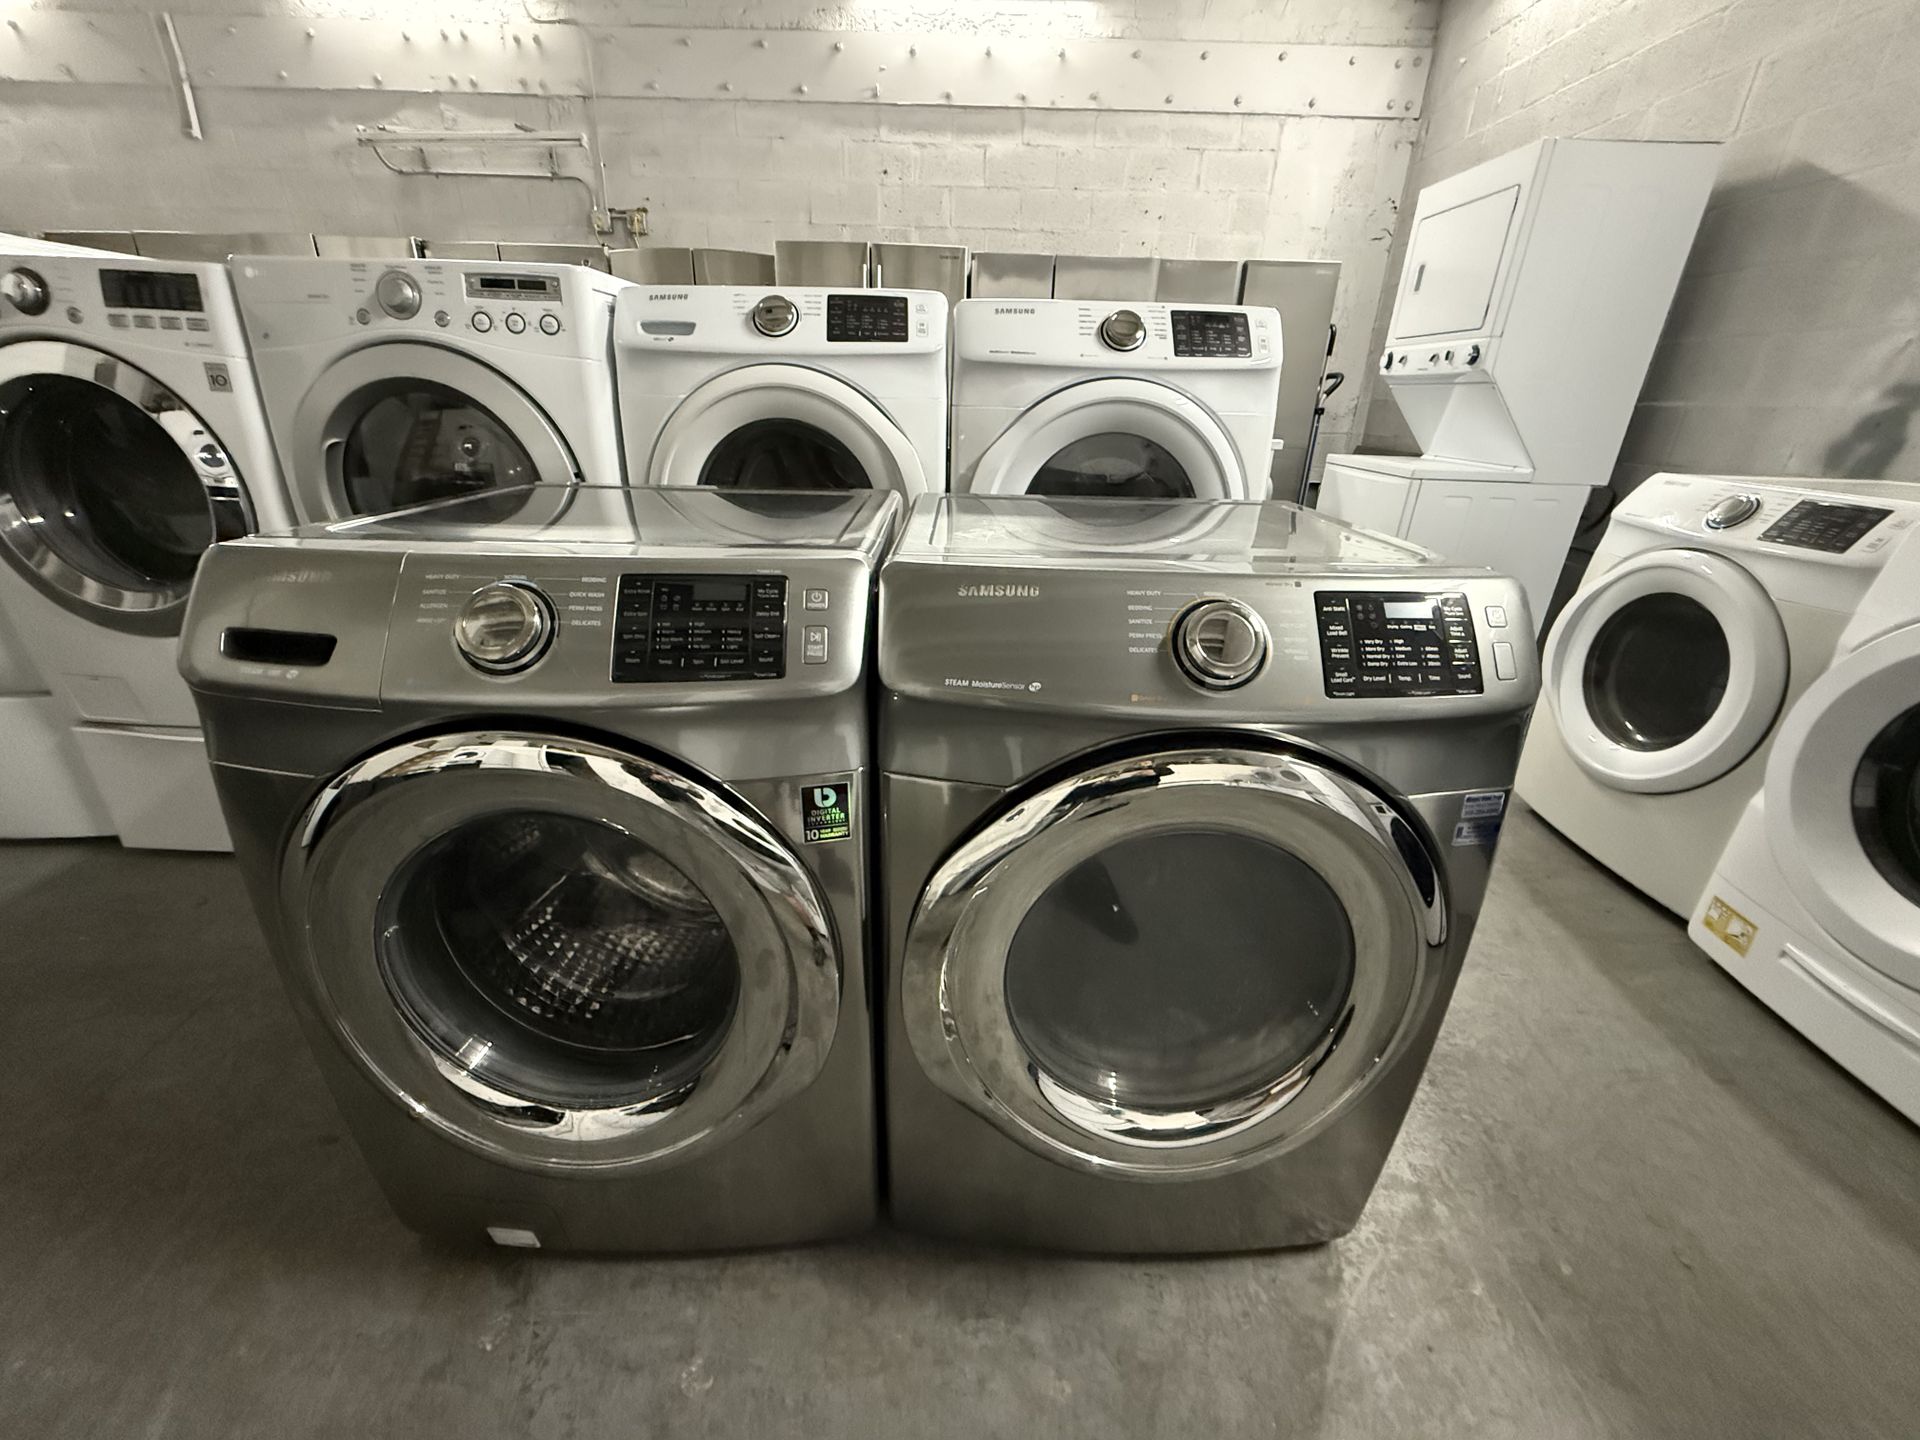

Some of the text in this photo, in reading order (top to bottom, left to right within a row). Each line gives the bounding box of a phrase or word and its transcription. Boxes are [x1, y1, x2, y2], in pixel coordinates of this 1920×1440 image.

[210, 374, 228, 386] 10
[957, 584, 1040, 597] SAMSUNG
[944, 678, 969, 687] STEAM
[972, 680, 1025, 690] MoistureSensor
[808, 812, 845, 822] INVERTER
[810, 807, 840, 816] DIGITAL
[805, 830, 819, 840] 10
